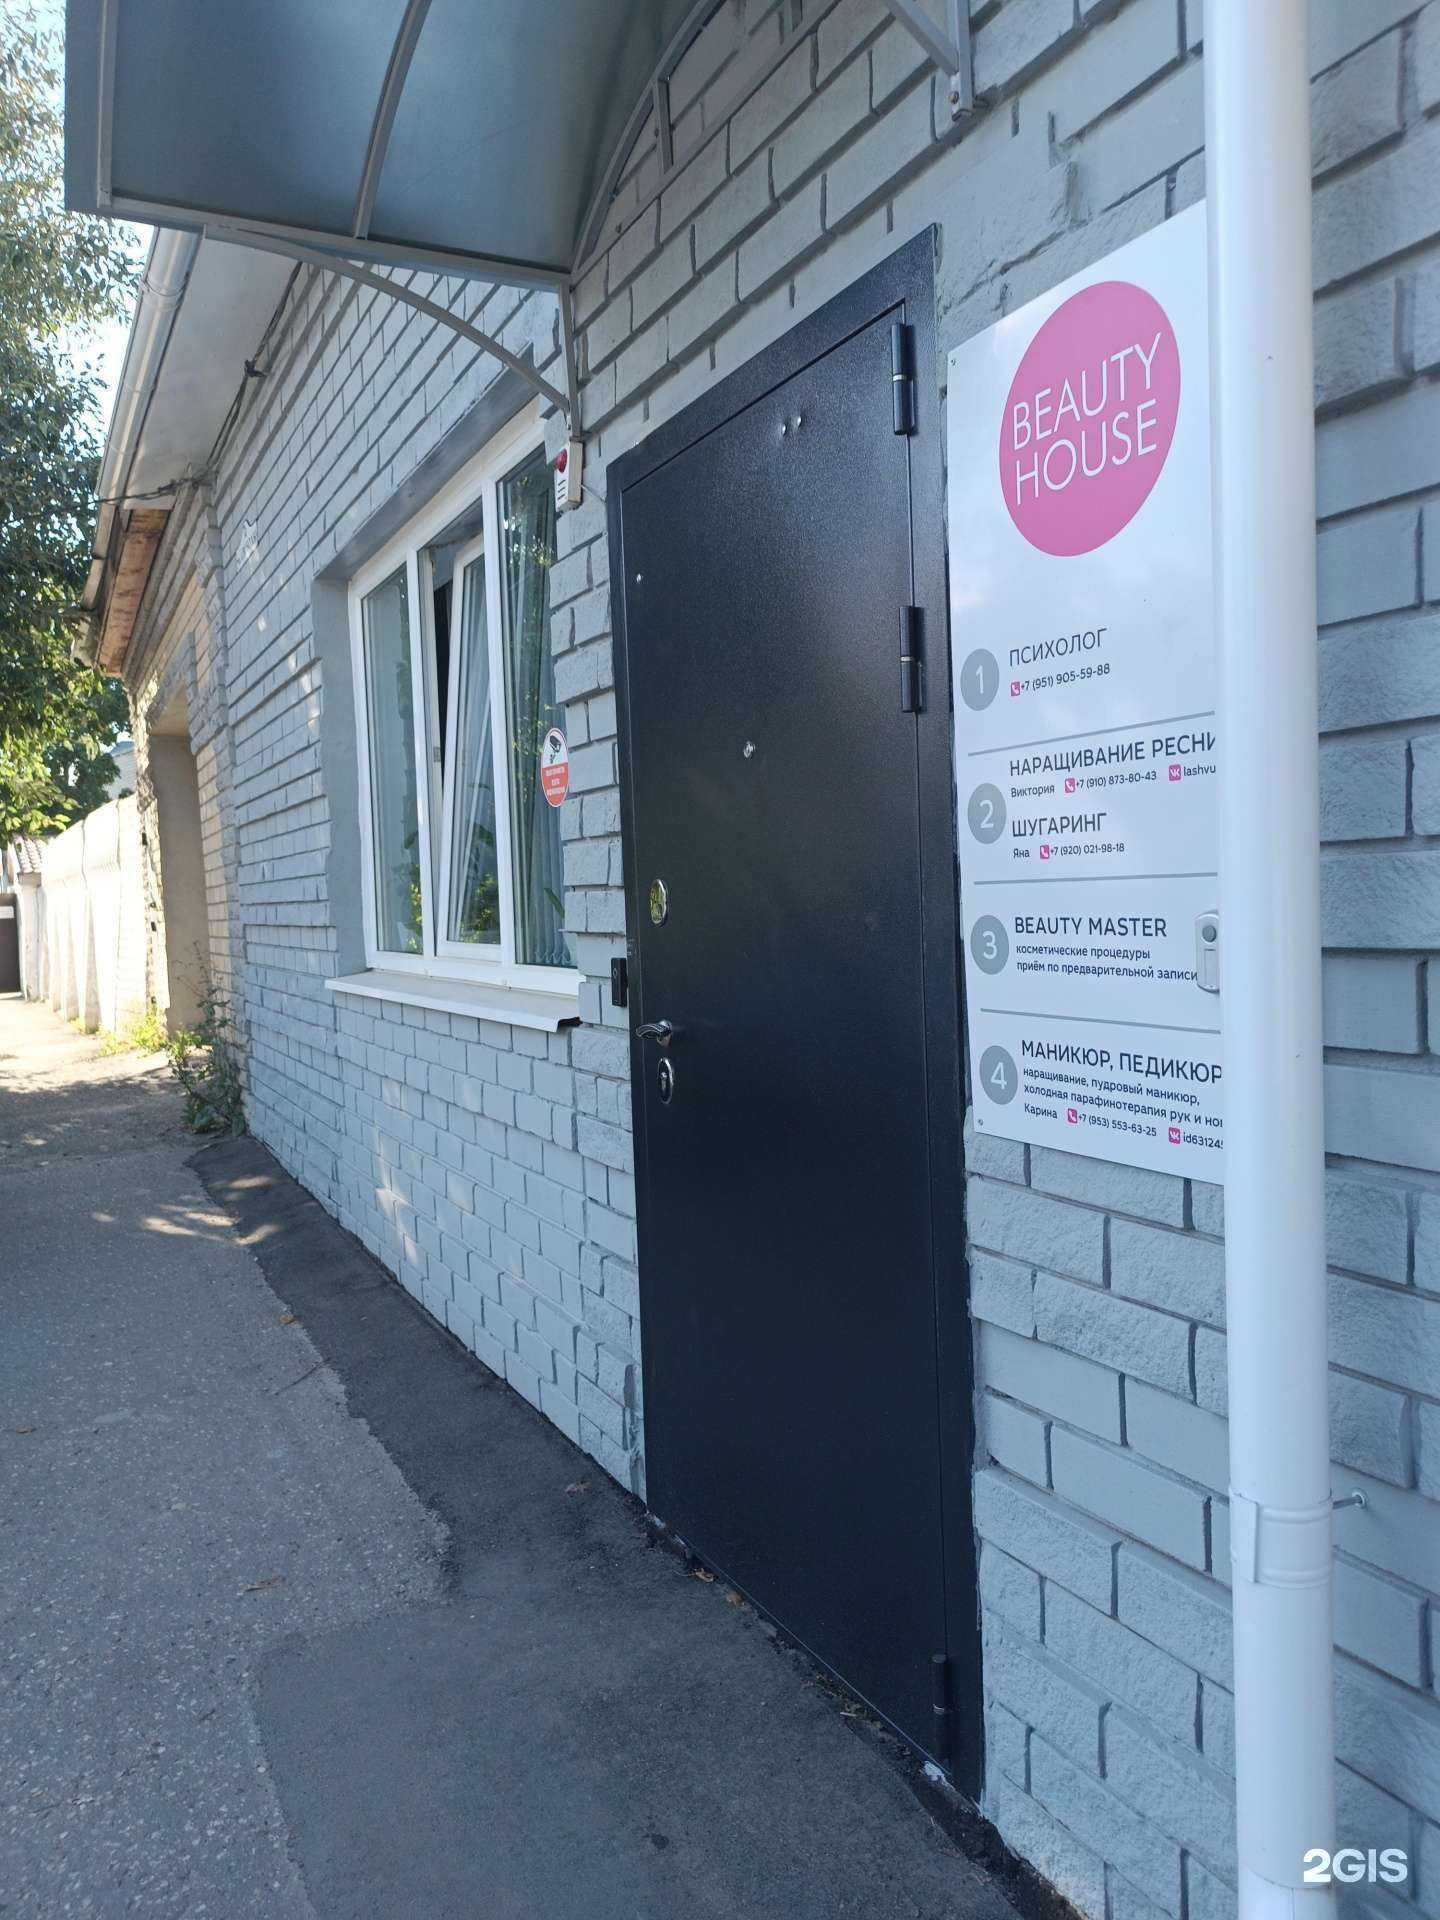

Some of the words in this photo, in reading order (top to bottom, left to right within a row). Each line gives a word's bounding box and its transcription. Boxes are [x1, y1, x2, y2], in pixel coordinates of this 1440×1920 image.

[1013, 332, 1161, 450] BEAUTY
[1015, 398, 1157, 506] HOUSE
[1009, 628, 1107, 667] ПСИХОЛОГ
[976, 665, 985, 694] 1
[1032, 676, 1054, 691] (951)
[1056, 663, 1110, 685] 905-59-88
[1010, 741, 1146, 776] НАРАЩИВАНИЕ
[1011, 785, 1055, 798] Виктория
[1086, 777, 1107, 789] (910)
[1108, 771, 1157, 785] 873-80-43
[979, 799, 994, 829] 2
[1012, 812, 1107, 837] ШУГАРИНГ
[1013, 849, 1030, 858] Яна
[1060, 844, 1082, 856] (920)
[1083, 842, 1125, 854] 021-98-18
[1014, 916, 1082, 935] BEAUTY
[1088, 917, 1167, 937] MASTER
[982, 930, 998, 960] 3
[1016, 945, 1088, 957] косметические
[1090, 947, 1151, 961] процедуры
[1017, 960, 1045, 973] приём
[1047, 963, 1059, 973] по
[1061, 964, 1154, 979] предварительной
[1157, 970, 1198, 981] записи
[990, 1061, 1008, 1091] 4
[1021, 1039, 1114, 1071] МАНИКЮР,
[1119, 1052, 1222, 1083] ПЕДИКЮР
[1023, 1068, 1089, 1088] наращивание,
[1091, 1079, 1143, 1096] пудровый
[1146, 1088, 1200, 1107] маникюр,
[1024, 1084, 1068, 1100] холодная
[1070, 1091, 1167, 1118] парафинотерапия
[1170, 1111, 1190, 1123] рук
[1194, 1114, 1202, 1125] и
[1024, 1103, 1058, 1119] Карина
[1089, 1115, 1110, 1129] (953)
[1111, 1119, 1157, 1137] 553-63-25
